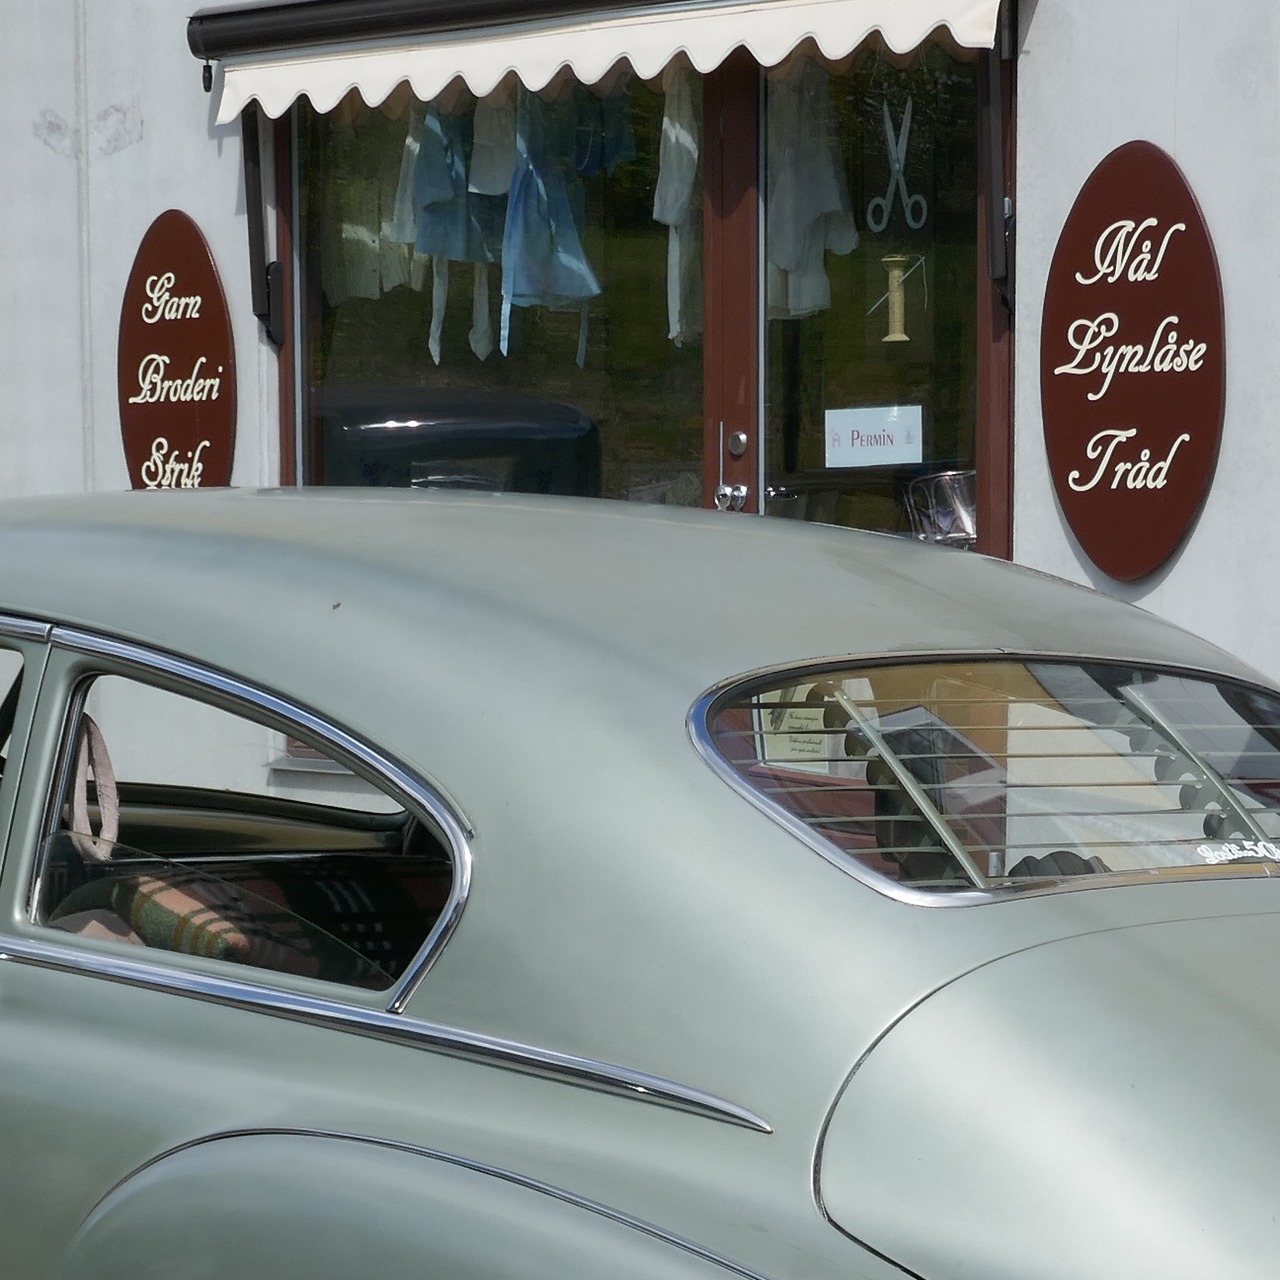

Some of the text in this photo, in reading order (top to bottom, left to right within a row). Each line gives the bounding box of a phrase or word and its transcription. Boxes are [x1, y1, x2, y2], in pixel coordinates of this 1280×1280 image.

[1075, 217, 1186, 285] Nål
[141, 272, 202, 324] Garn
[128, 353, 223, 404] Broderi
[1053, 312, 1207, 401] Lynlåse
[141, 436, 210, 486] Strik
[1068, 428, 1191, 492] Tråd
